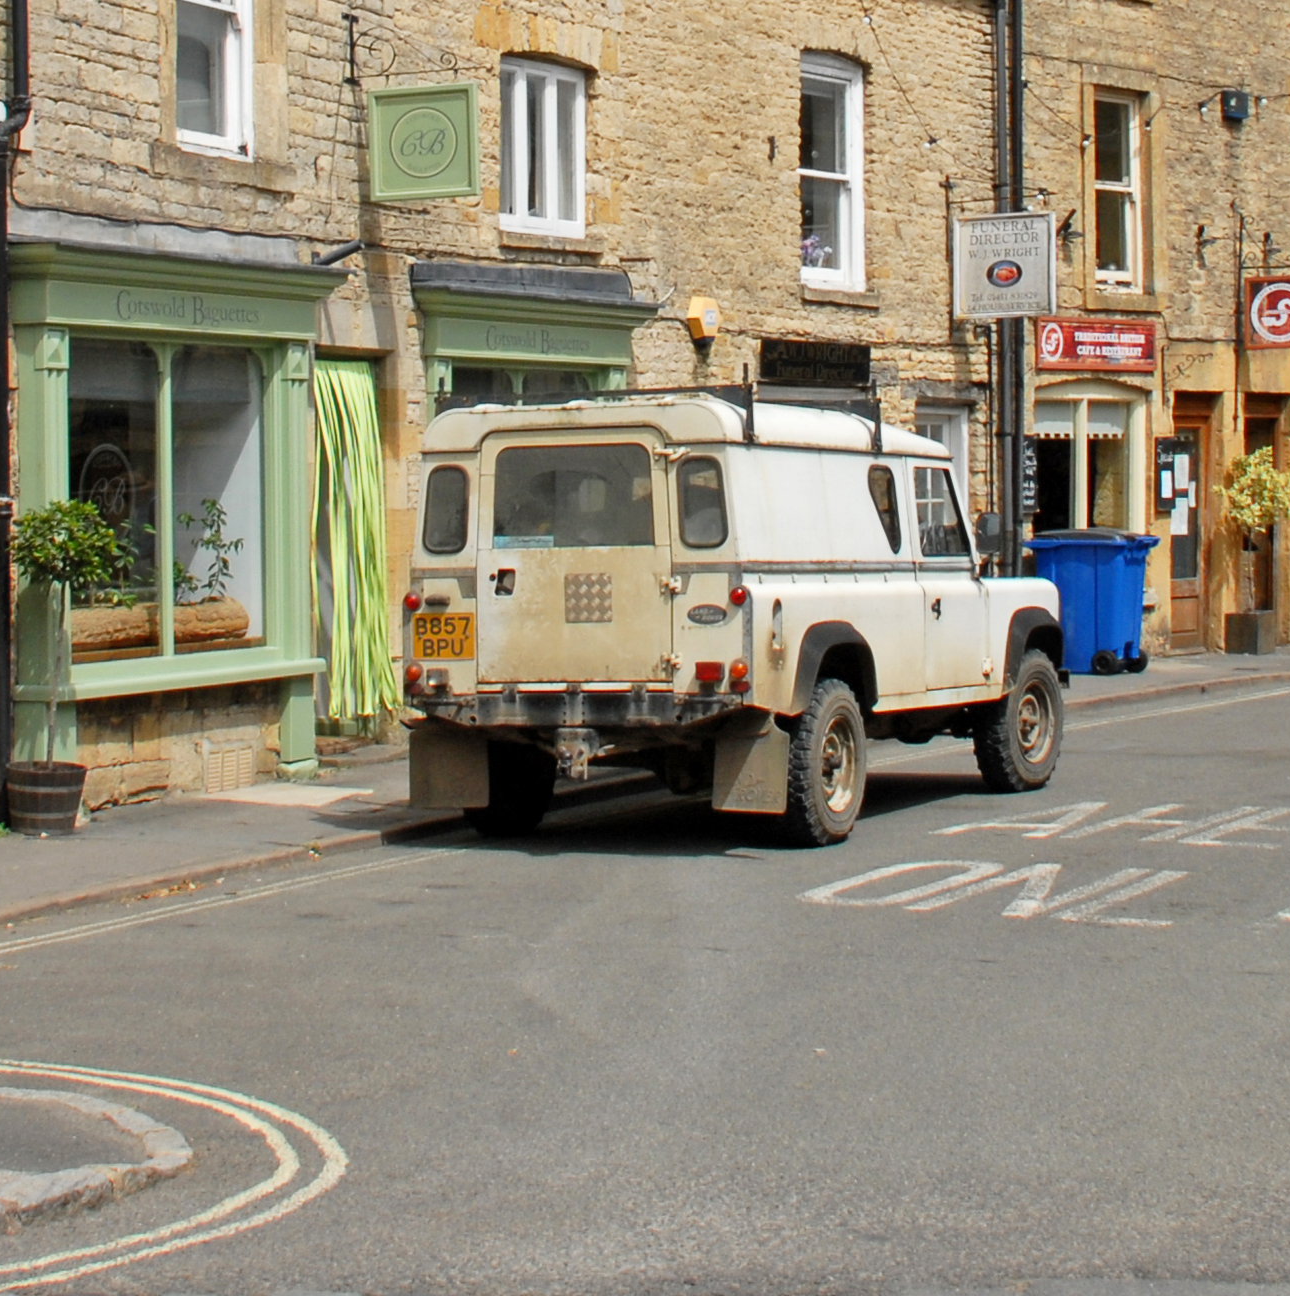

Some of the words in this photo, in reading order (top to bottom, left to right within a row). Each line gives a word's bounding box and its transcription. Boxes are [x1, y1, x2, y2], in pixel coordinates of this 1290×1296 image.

[971, 219, 1038, 233] FUNERAL
[970, 232, 1039, 245] DIRECTOR
[992, 246, 1040, 258] WRIGHT
[116, 289, 185, 321] Cotswold
[192, 296, 260, 328] Baguettes
[486, 325, 536, 351] Cotswold
[416, 616, 471, 635] B857
[423, 637, 464, 657] BPU
